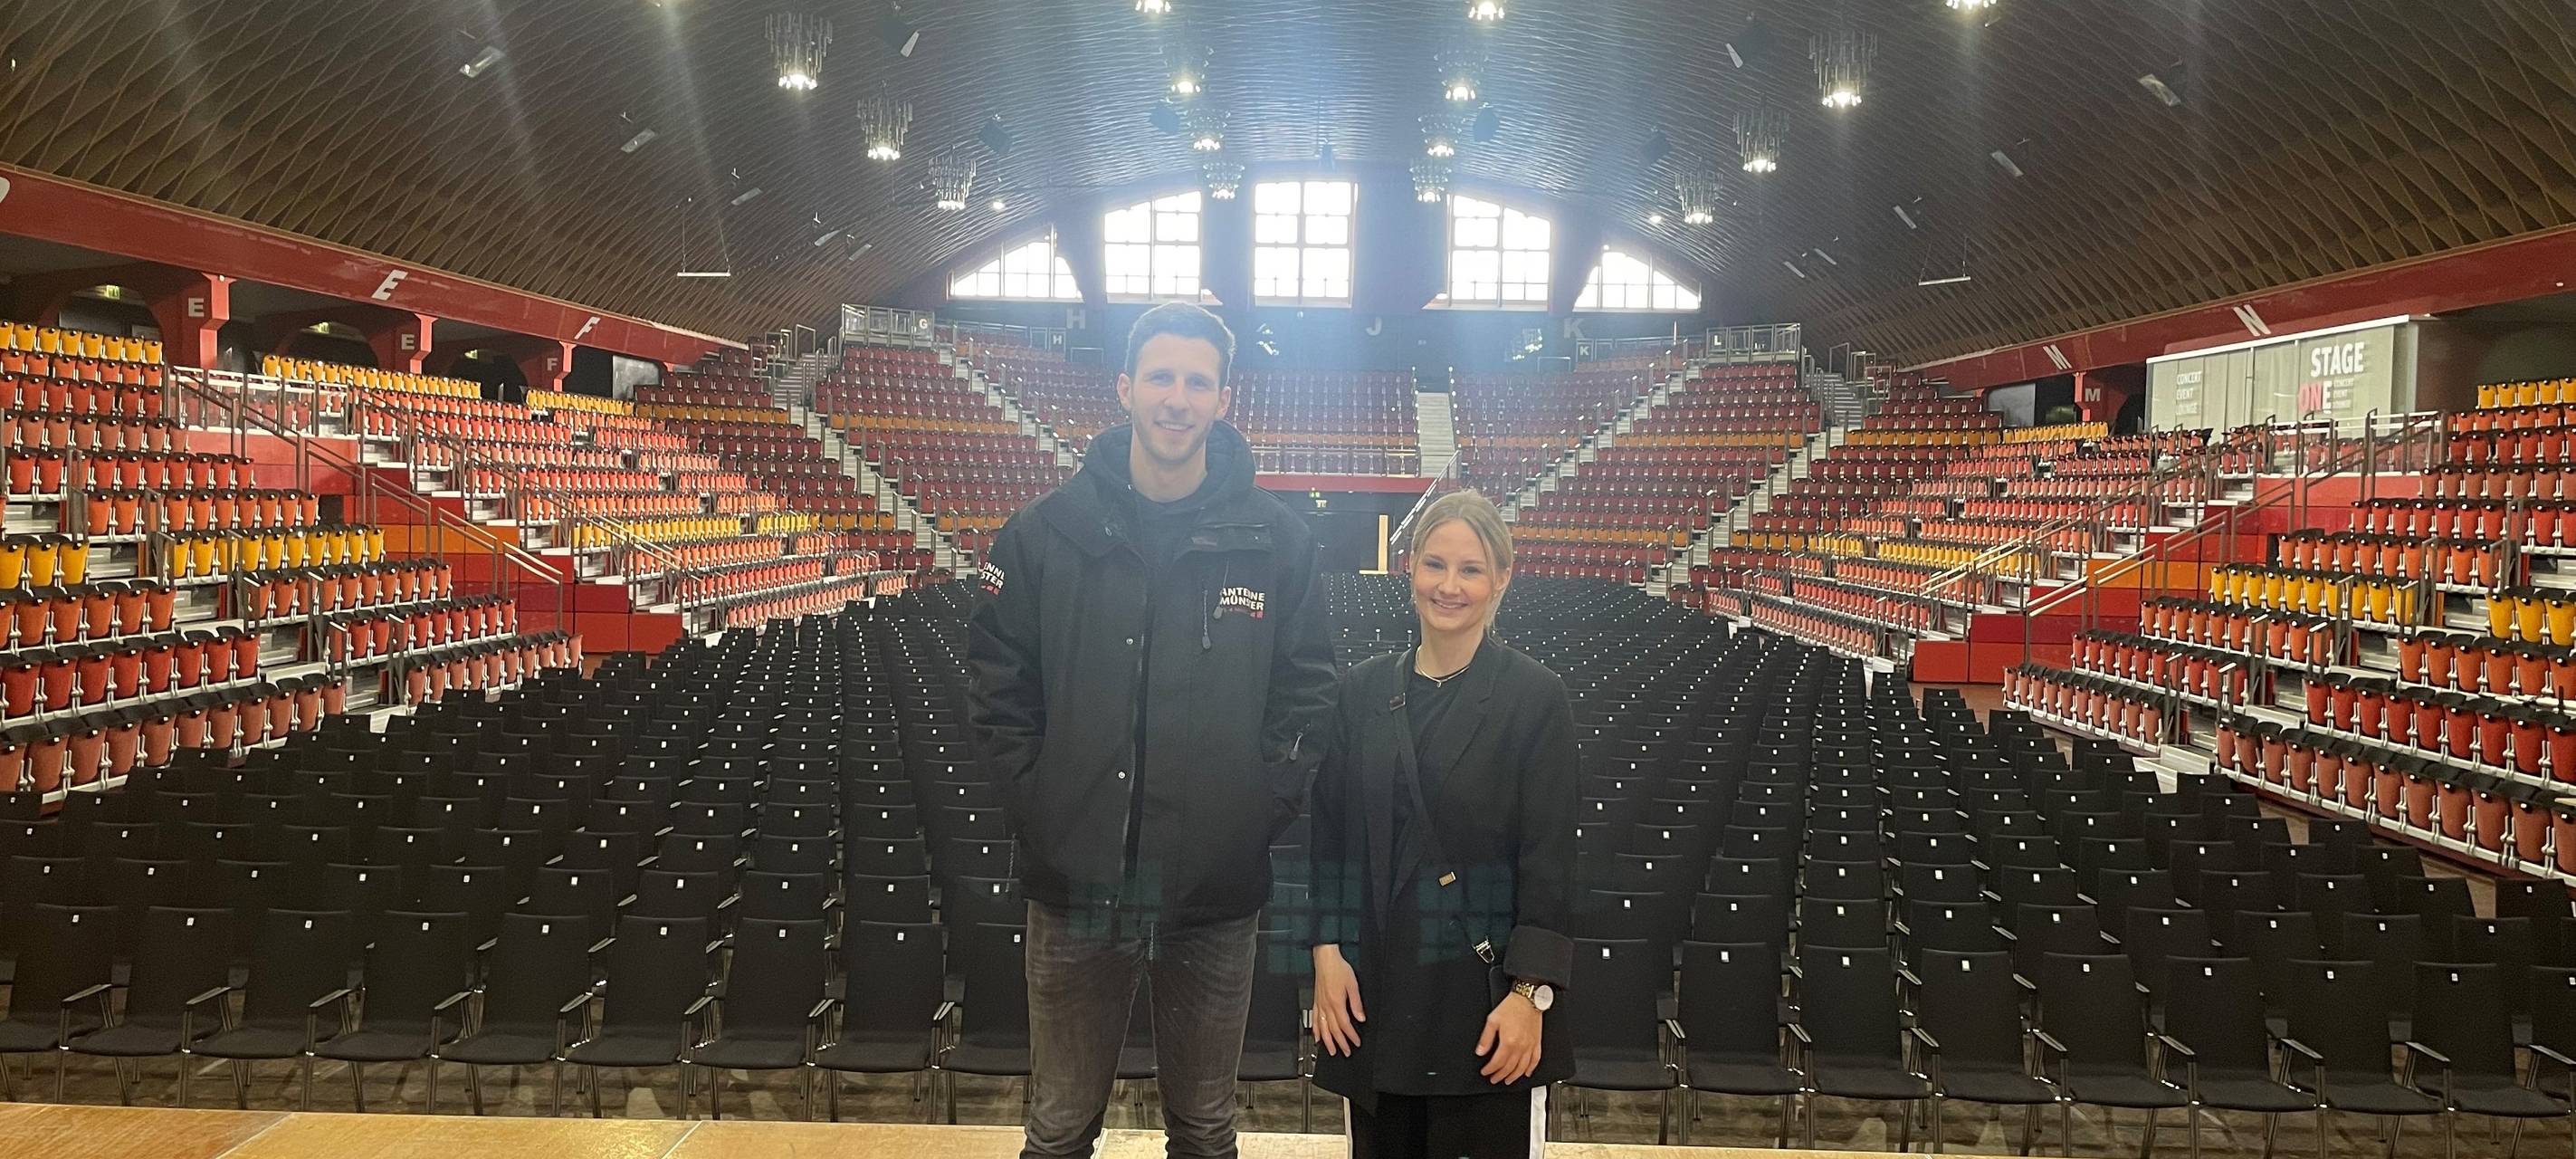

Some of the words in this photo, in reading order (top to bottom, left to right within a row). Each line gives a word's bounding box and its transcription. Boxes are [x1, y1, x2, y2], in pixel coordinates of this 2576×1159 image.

[371, 269, 408, 301] E
[188, 297, 205, 317] E
[919, 319, 928, 329] G
[1066, 308, 1085, 329] H
[1365, 317, 1382, 336] J
[2233, 304, 2271, 337] N
[574, 317, 601, 340] F
[1563, 318, 1585, 339] K
[401, 334, 415, 350] E
[1053, 335, 1062, 344] H
[1713, 335, 1722, 346] L
[1579, 346, 1589, 356] K
[2311, 341, 2365, 378] STAGE
[547, 358, 558, 371] F
[2177, 371, 2202, 385] CONCERT
[2085, 388, 2101, 402] M
[2177, 388, 2193, 400] EVENT
[2298, 380, 2333, 411] ONE
